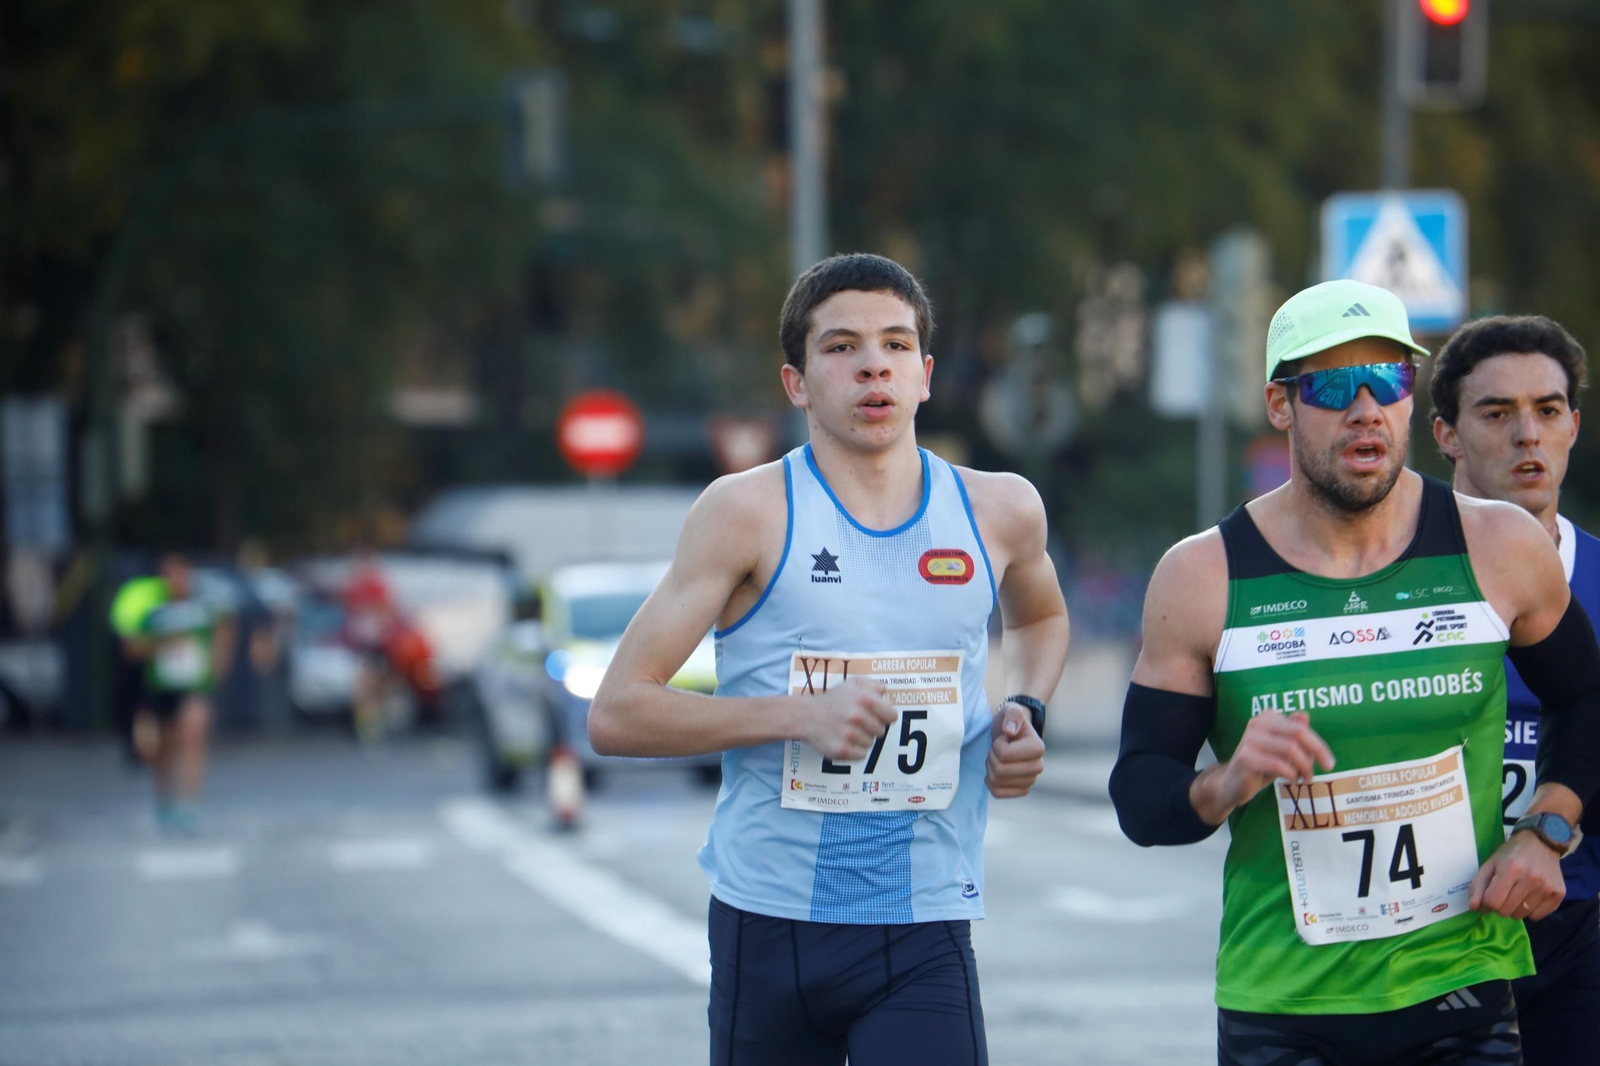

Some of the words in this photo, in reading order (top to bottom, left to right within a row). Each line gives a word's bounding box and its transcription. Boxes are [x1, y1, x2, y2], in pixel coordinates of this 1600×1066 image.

[811, 574, 842, 583] luanvi
[1263, 600, 1307, 613] IMDECO
[1257, 639, 1306, 653] CÓRDOBA
[871, 659, 905, 672] CARRERA
[906, 658, 937, 671] POPULAR
[890, 677, 917, 685] TRINIDAD
[920, 676, 952, 684] TRINITARIOS
[1251, 683, 1363, 717] ATLETISMO
[1371, 667, 1484, 703] CORDOBÉS
[1358, 774, 1399, 789] CARRERA
[1399, 764, 1437, 782] POPULAR
[1383, 788, 1415, 800] TRINIDAD
[1420, 775, 1456, 794] TRINITARIOS
[817, 797, 849, 806] IMDECO
[1283, 781, 1342, 830] XLI
[1343, 807, 1389, 824] MEMORIAL
[1342, 823, 1424, 898] 74
[1335, 923, 1369, 933] IMDECO
